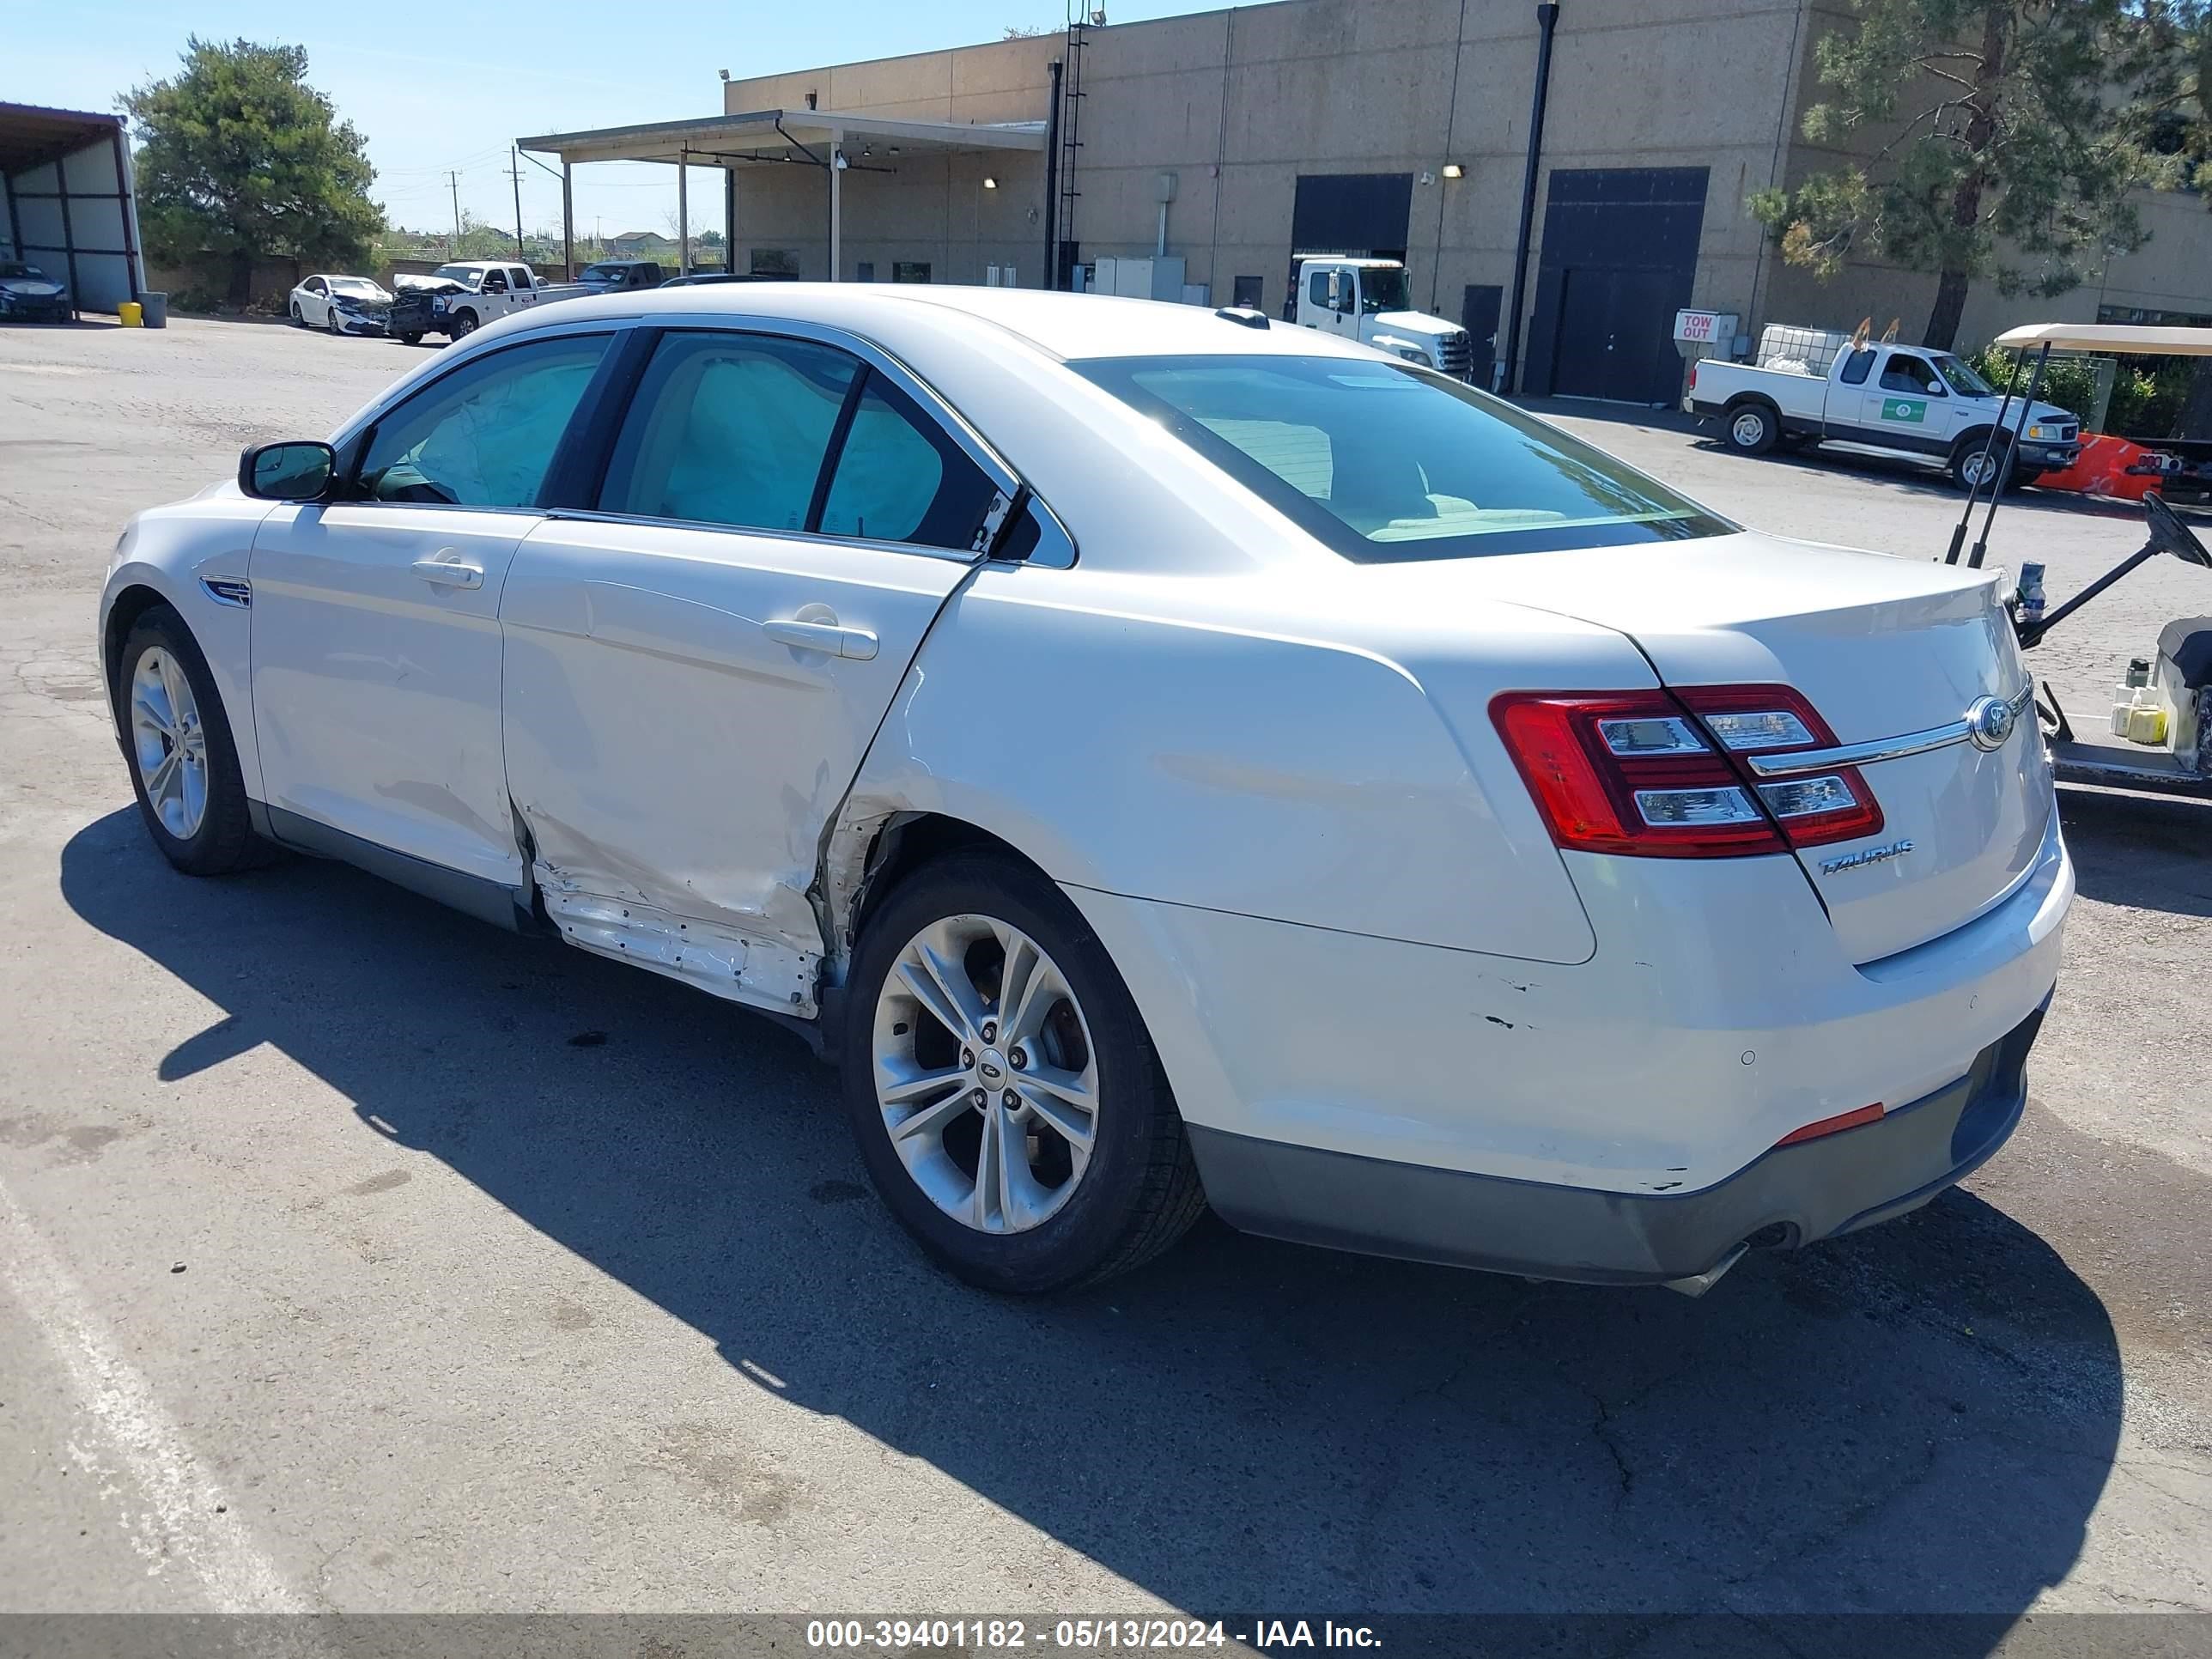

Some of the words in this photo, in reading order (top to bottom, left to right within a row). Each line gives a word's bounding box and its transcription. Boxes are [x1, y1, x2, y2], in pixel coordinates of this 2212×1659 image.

[1685, 315, 1712, 328] TOW
[1683, 327, 1710, 339] OUT
[1990, 706, 2012, 736] Ford
[1818, 838, 1917, 876] TAURUS
